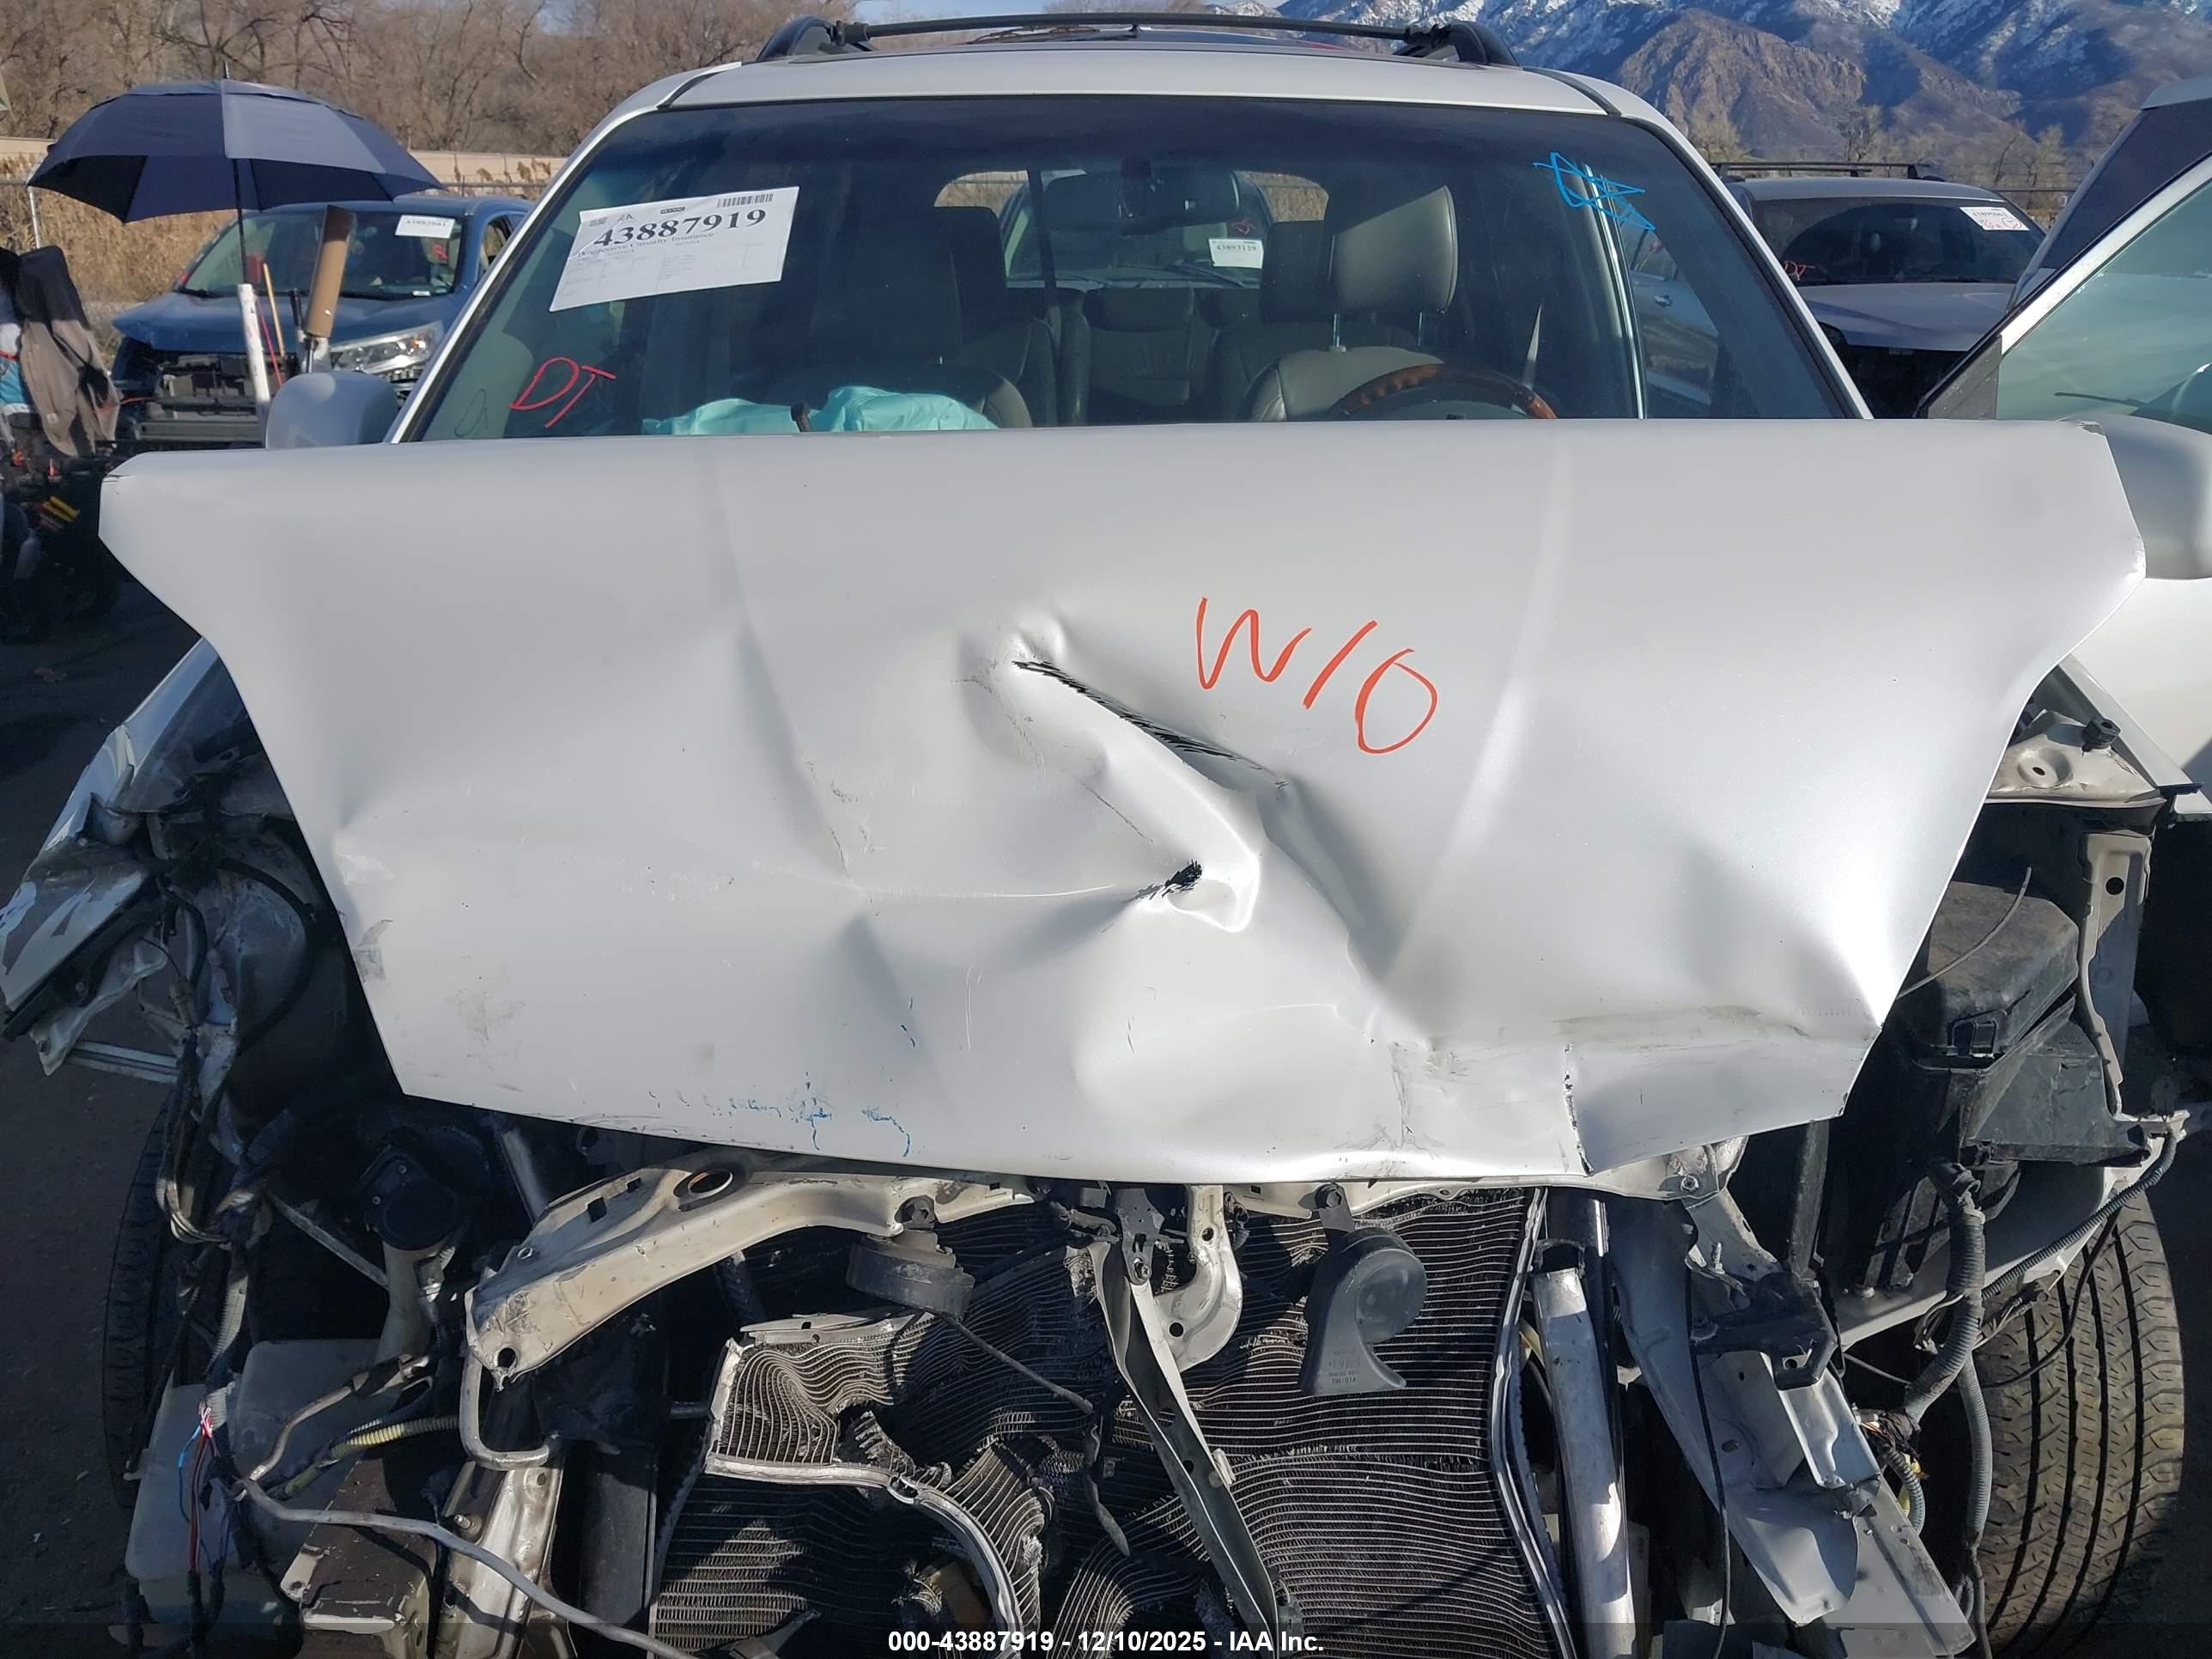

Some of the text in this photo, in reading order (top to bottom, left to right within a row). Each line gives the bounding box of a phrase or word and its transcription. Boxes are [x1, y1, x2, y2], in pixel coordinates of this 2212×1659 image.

[593, 209, 767, 246] 43887919
[672, 233, 714, 243] Insurance
[509, 356, 617, 428] DT
